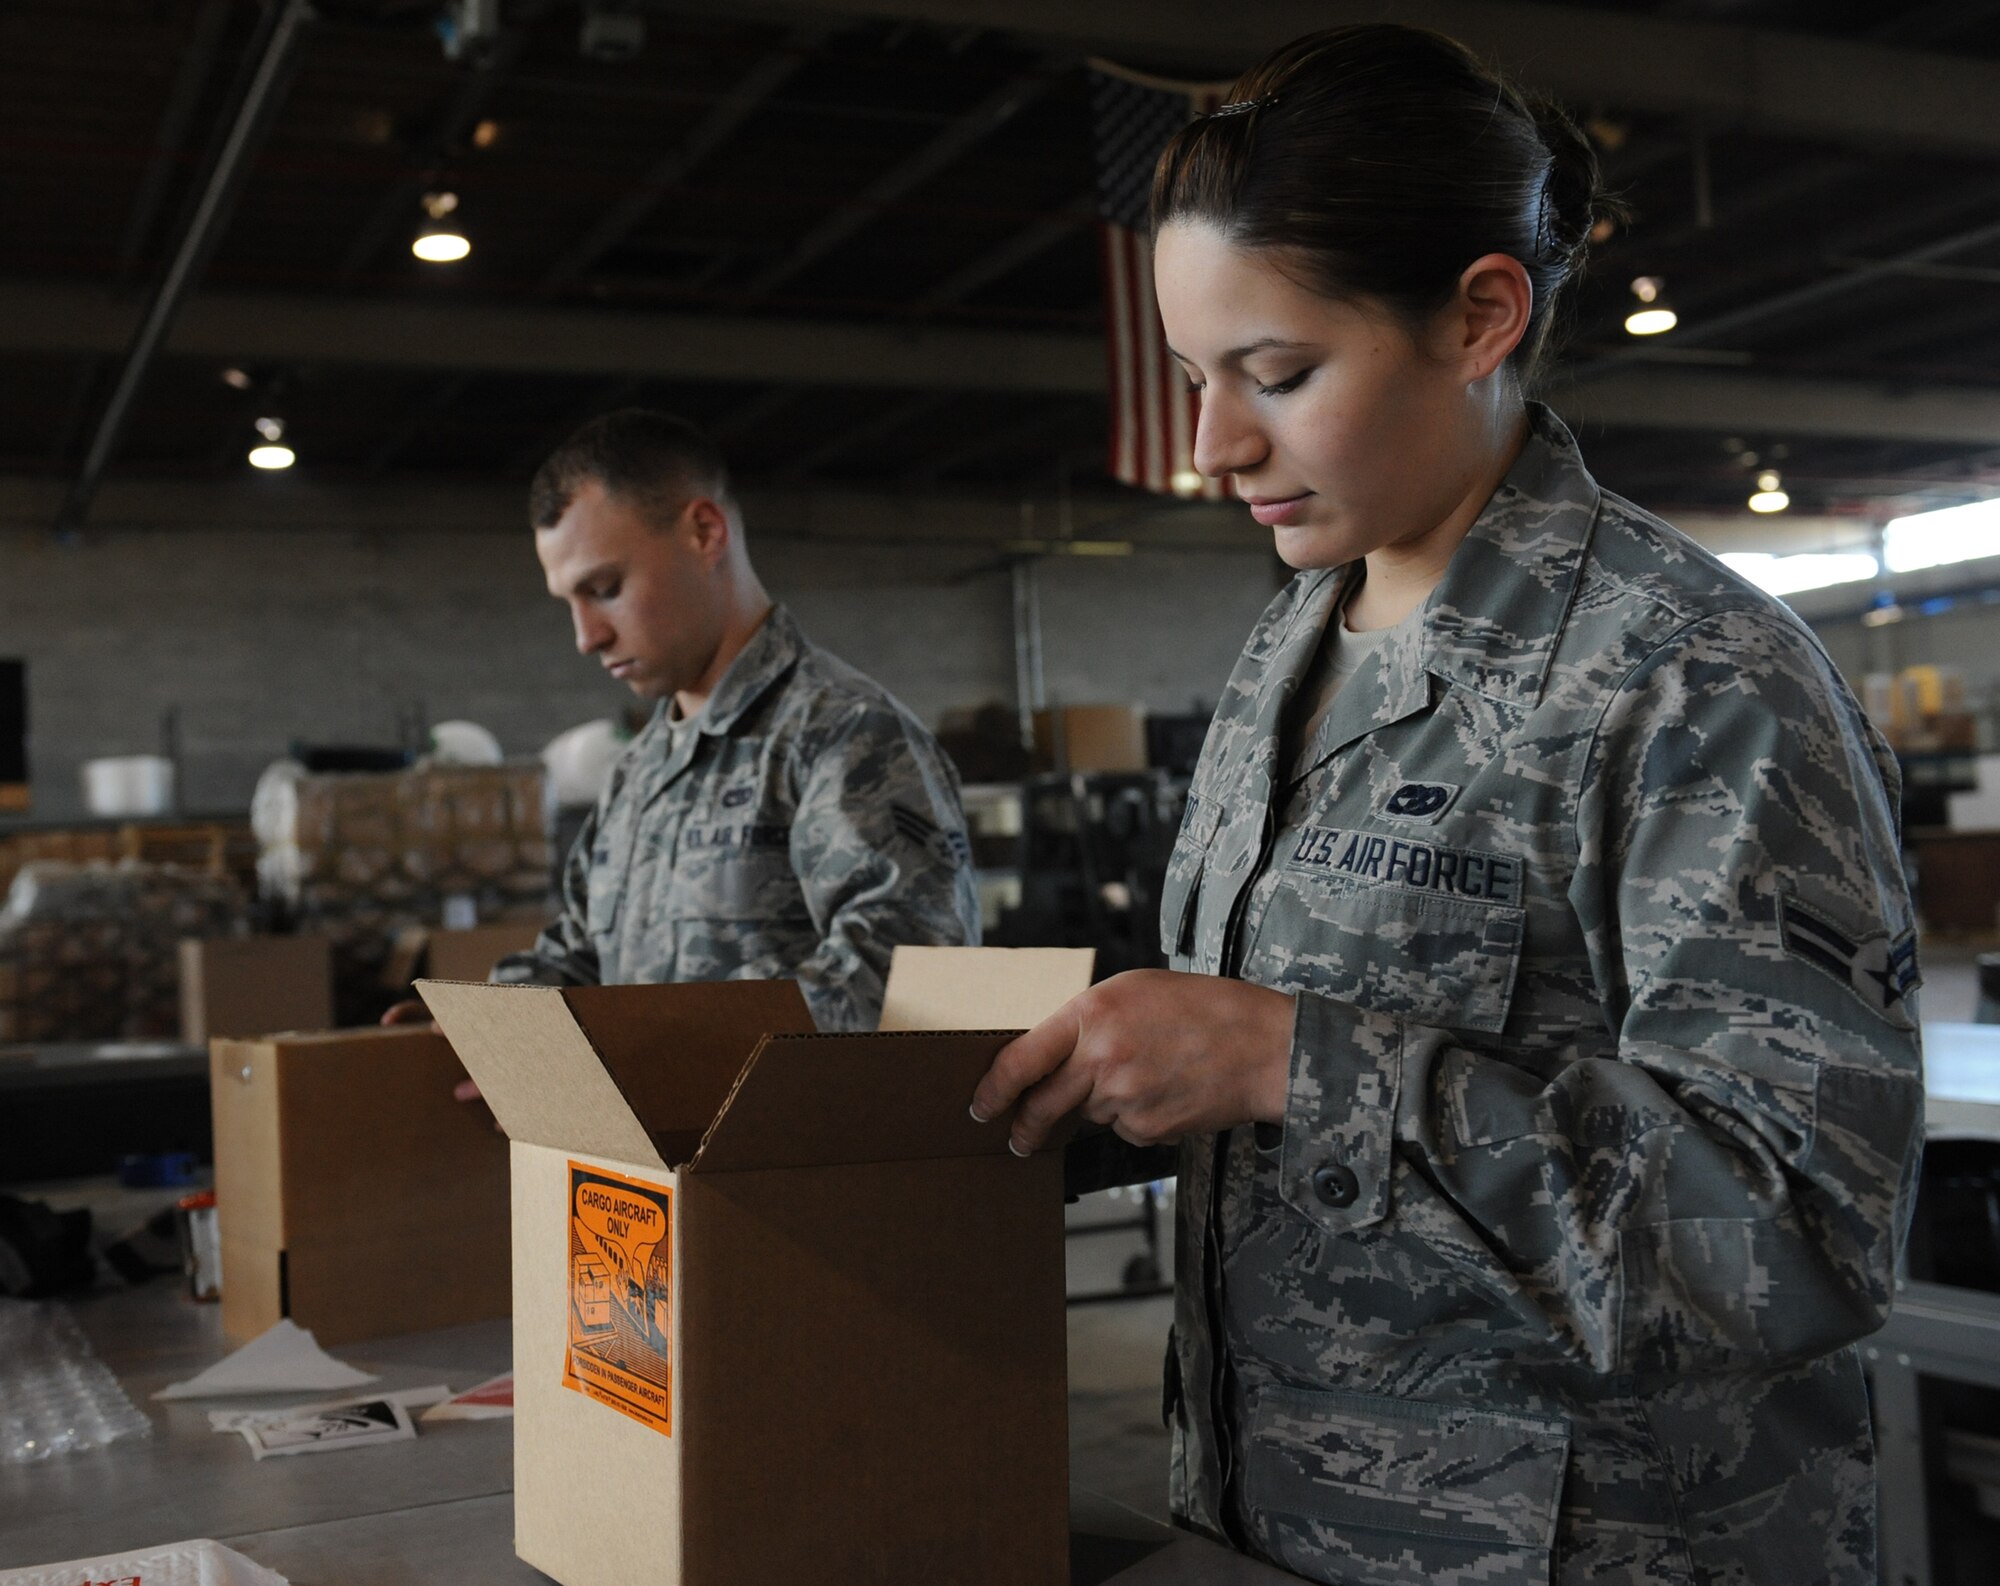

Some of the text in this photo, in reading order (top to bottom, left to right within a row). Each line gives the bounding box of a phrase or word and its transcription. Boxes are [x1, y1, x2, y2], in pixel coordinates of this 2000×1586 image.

[1293, 828, 1512, 900] U.S. AIR FORCE
[582, 1188, 657, 1227] CARGO AIRCRAFT
[607, 1217, 630, 1239] ONLY
[573, 1354, 601, 1376] FORBIDDEN
[607, 1370, 638, 1394] PASSENGER
[638, 1386, 665, 1407] AIRCRAFT
